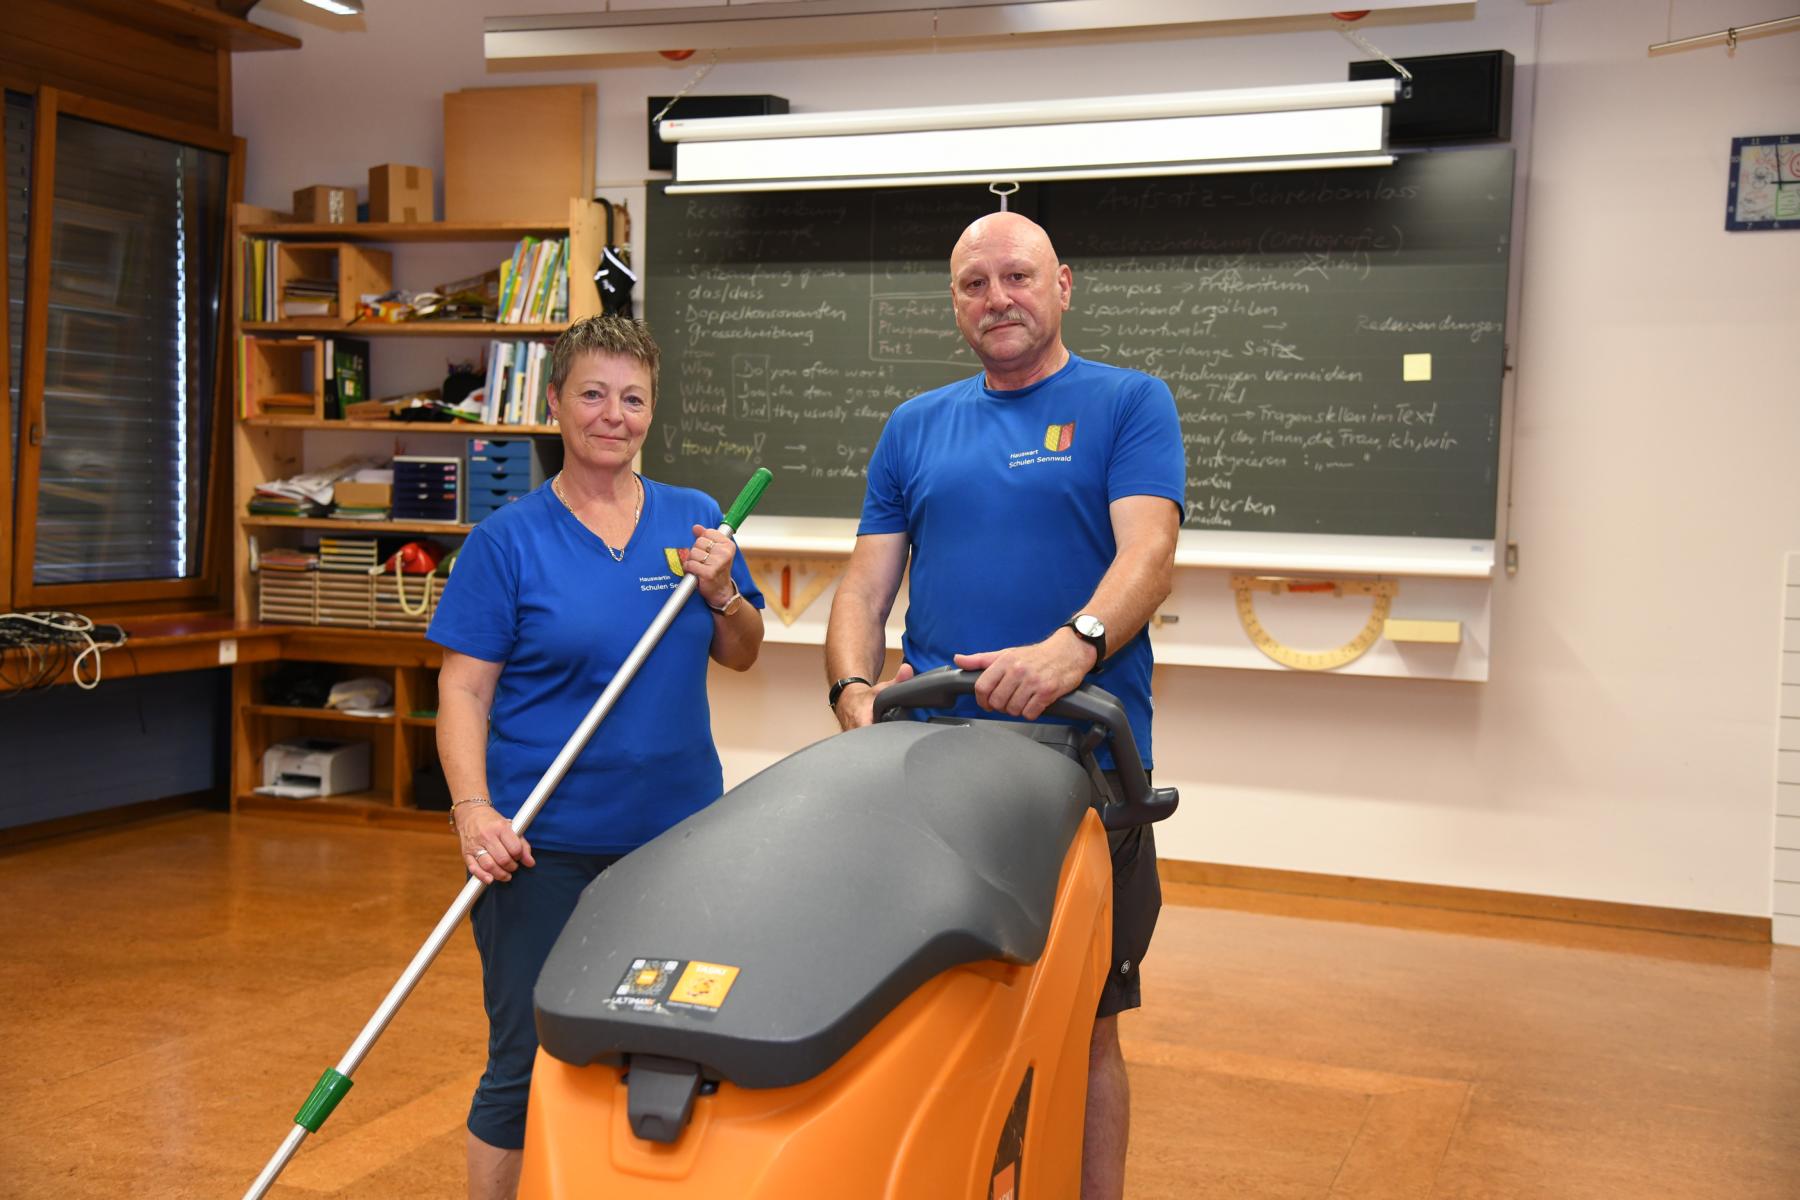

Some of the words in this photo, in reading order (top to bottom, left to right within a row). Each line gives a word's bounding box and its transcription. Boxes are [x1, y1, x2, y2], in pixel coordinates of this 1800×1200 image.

[1083, 276, 1164, 298] Tempus
[1008, 457, 1035, 469] Schulen
[1036, 455, 1072, 463] Sennwald
[640, 583, 668, 592] Schulen
